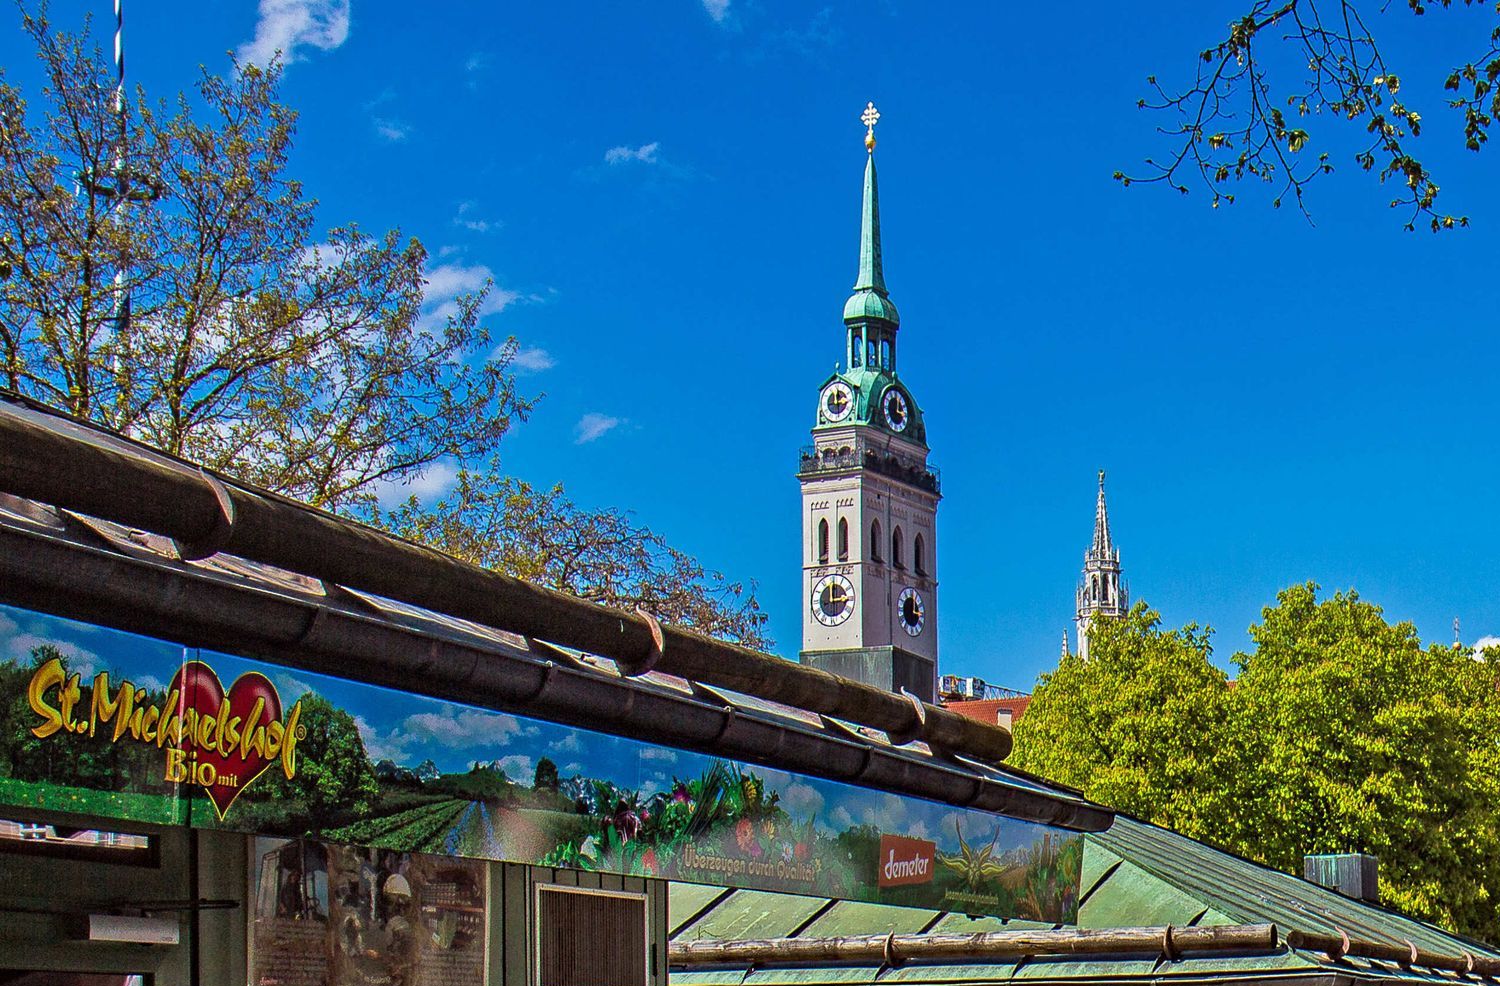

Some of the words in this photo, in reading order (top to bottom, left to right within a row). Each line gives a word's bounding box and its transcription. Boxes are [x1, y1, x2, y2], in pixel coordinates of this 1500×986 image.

[164, 746, 217, 787] Bio
[218, 773, 238, 788] mit
[684, 843, 746, 877] Überzeugen
[748, 857, 774, 877] durch
[884, 849, 929, 880] demeter
